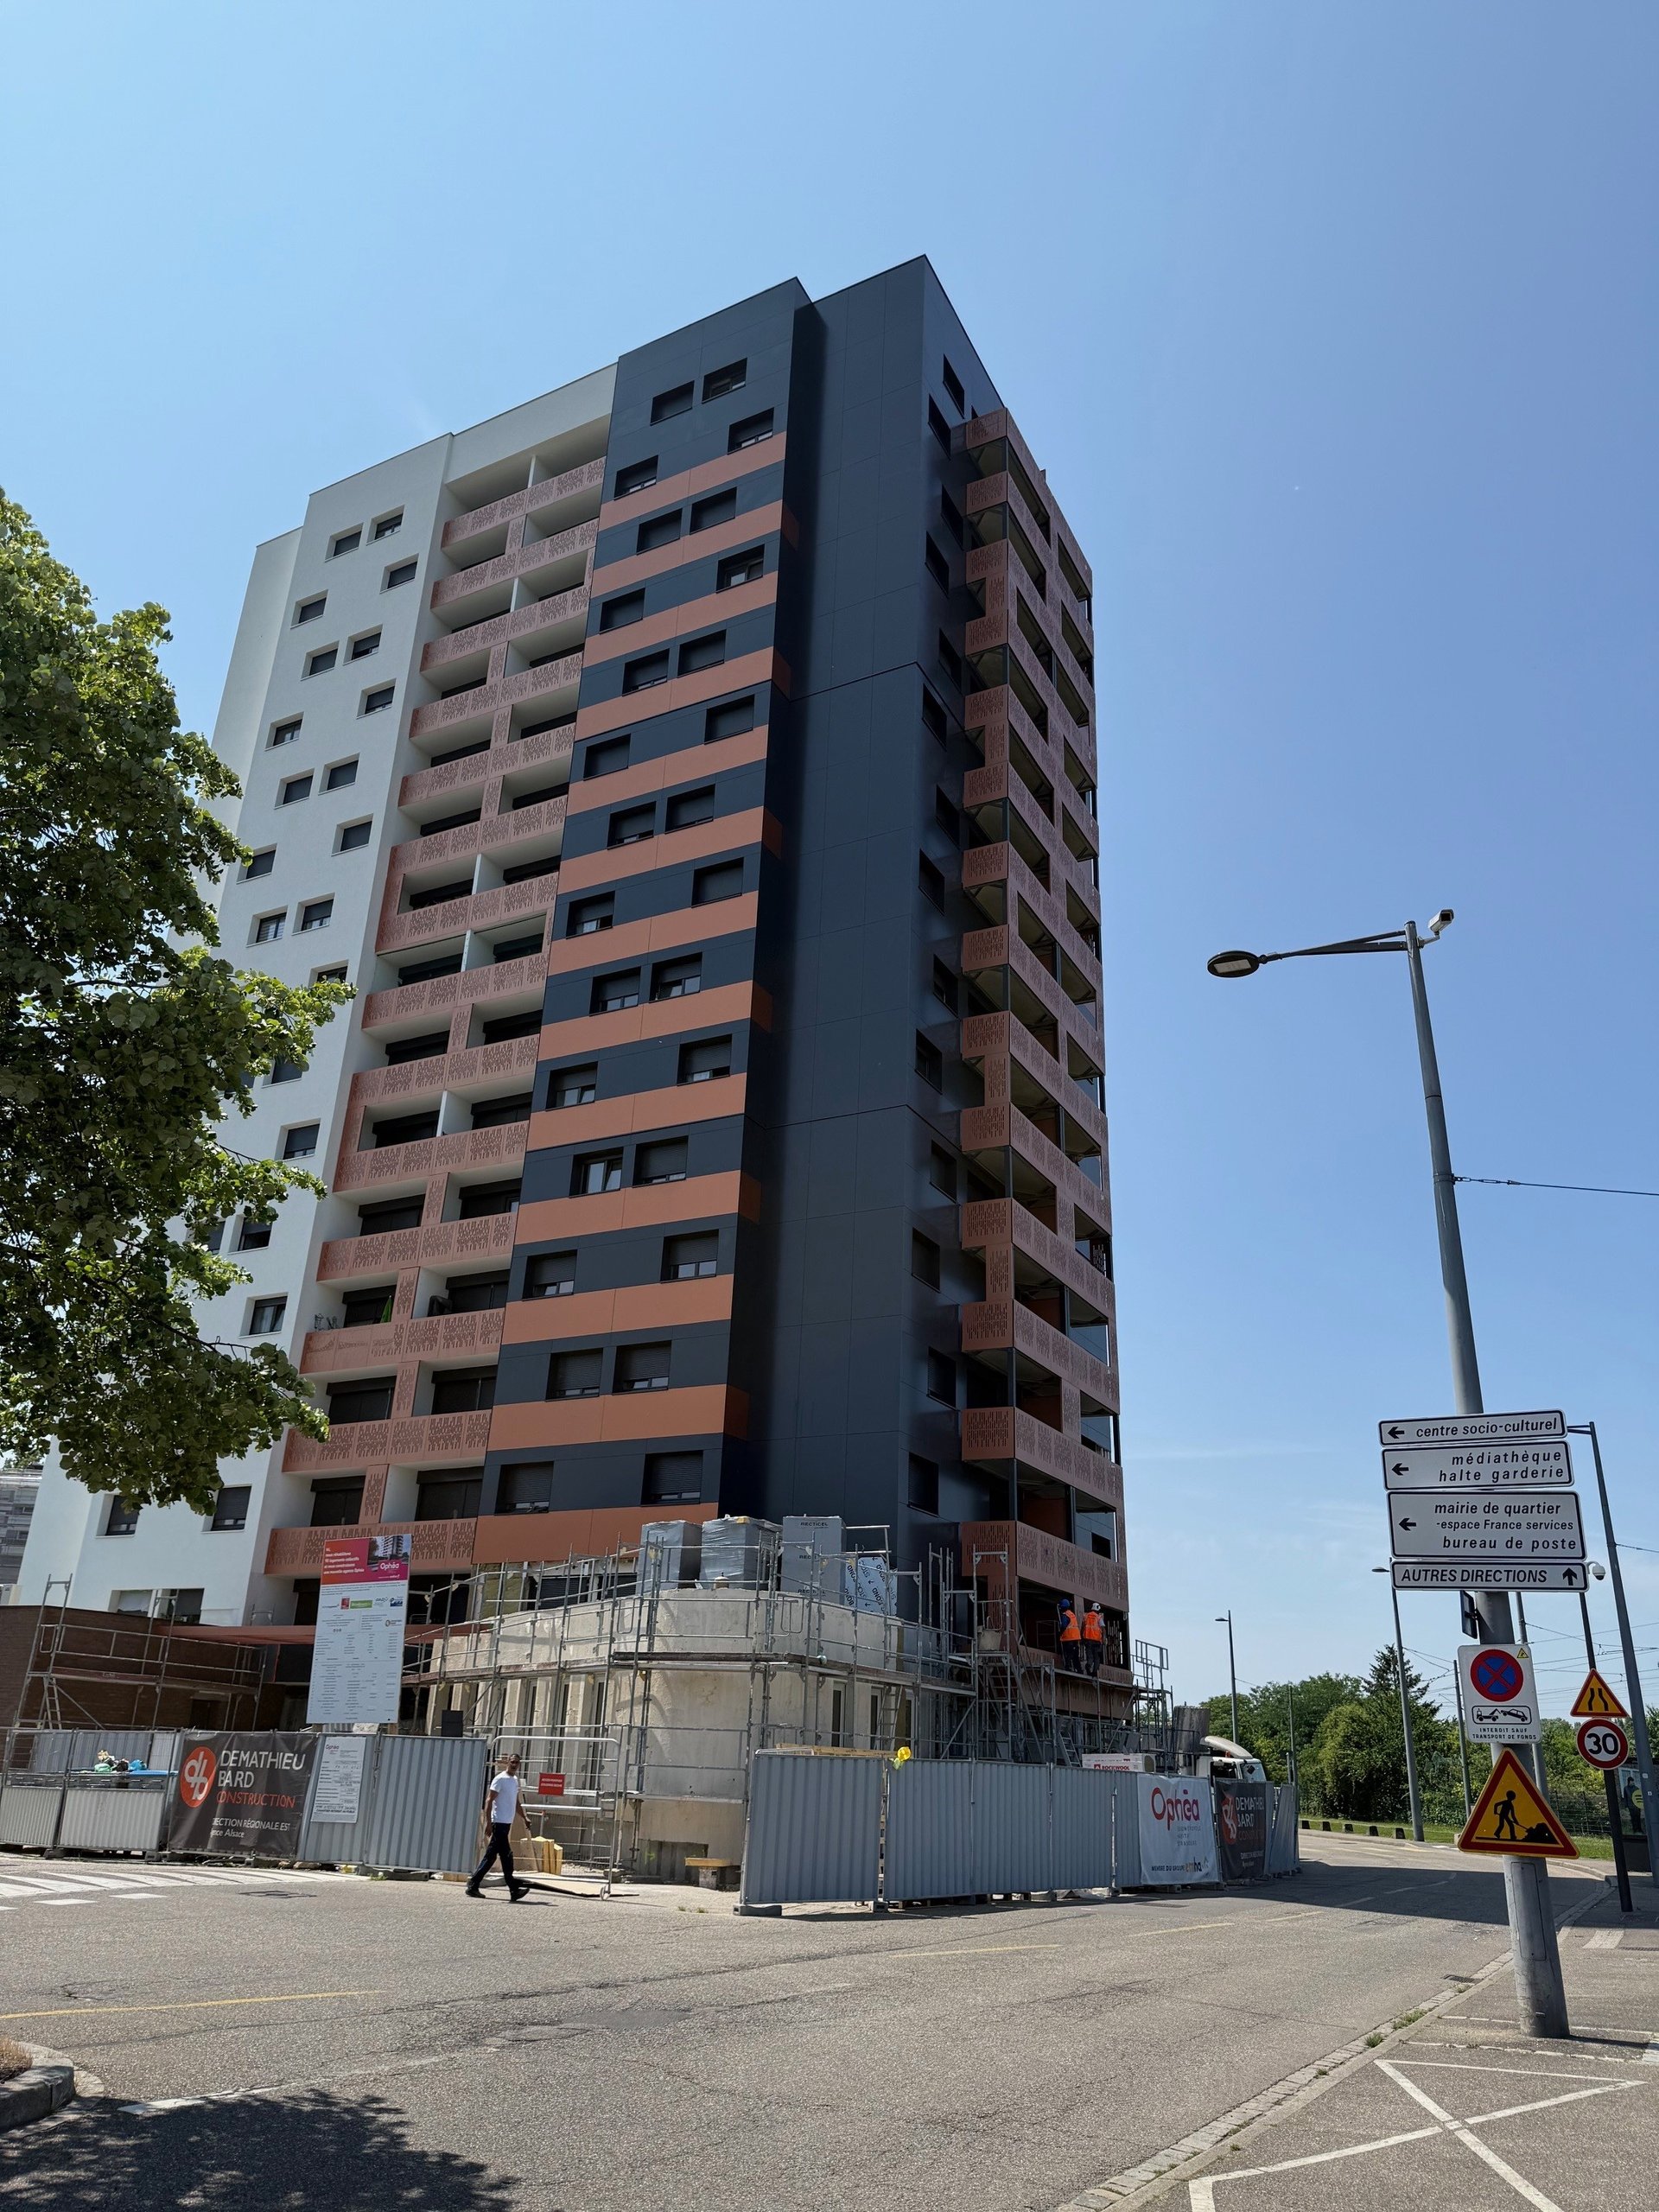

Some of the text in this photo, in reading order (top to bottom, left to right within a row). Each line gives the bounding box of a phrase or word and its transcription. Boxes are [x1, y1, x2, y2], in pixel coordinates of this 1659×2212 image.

[1416, 1417, 1557, 1438] centre socio-culturel
[1452, 1450, 1562, 1467] médiathèque
[1439, 1465, 1564, 1484] halte garderie
[1434, 1501, 1561, 1517] mairie de quartier
[1436, 1519, 1574, 1532] -espace France services
[1442, 1535, 1576, 1553] bureau de poste
[1401, 1568, 1548, 1583] AUTRES DIRECTIONS
[1586, 1732, 1619, 1755] 30
[219, 1750, 306, 1770] DEMATHIEU
[218, 1770, 255, 1789] BARD
[216, 1790, 296, 1808] CONSTRUCTION
[1151, 1787, 1201, 1831] Ophéa
